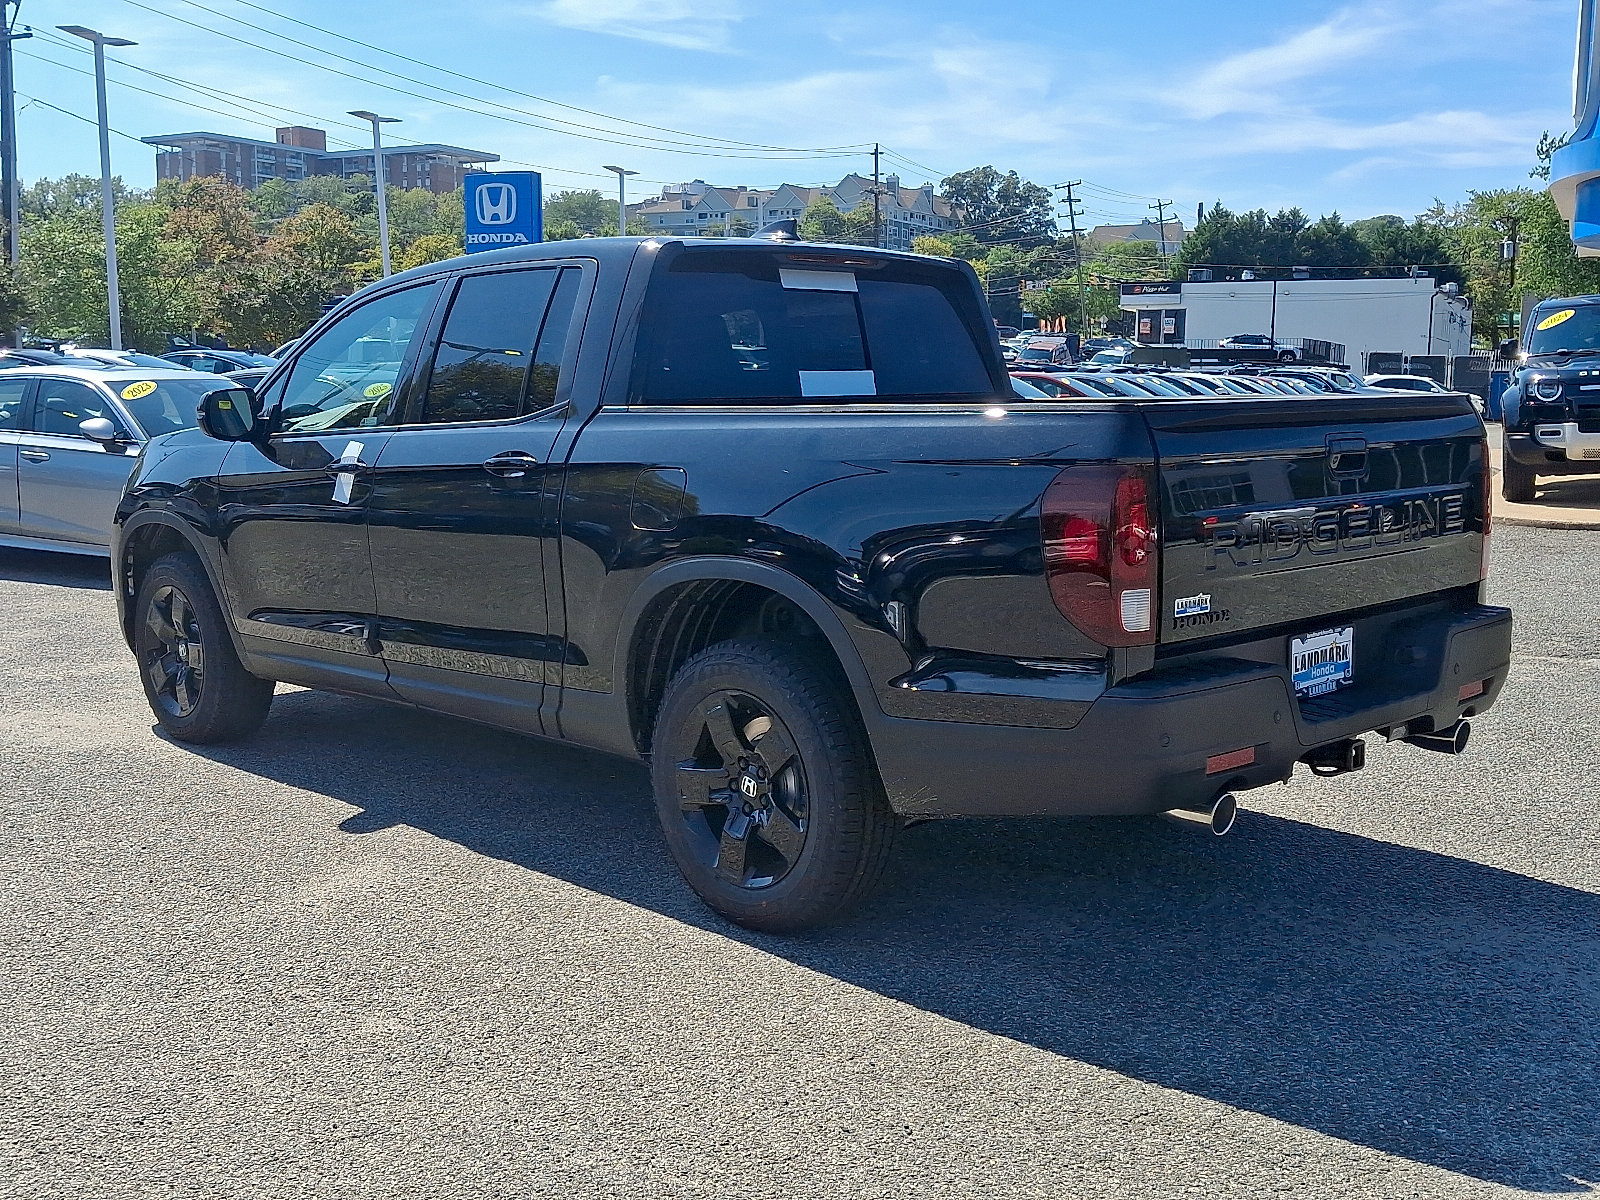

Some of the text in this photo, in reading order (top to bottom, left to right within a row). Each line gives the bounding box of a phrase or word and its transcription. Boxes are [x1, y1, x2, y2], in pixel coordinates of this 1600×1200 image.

[467, 233, 529, 244] HONDA
[1544, 312, 1568, 327] 2024
[127, 382, 152, 397] 2023
[1203, 494, 1466, 571] RIDGELINE
[1177, 597, 1209, 610] LANDMARK
[1172, 609, 1231, 630] HONDA
[1294, 643, 1349, 673] LANDMARK
[1311, 664, 1335, 678] Honda
